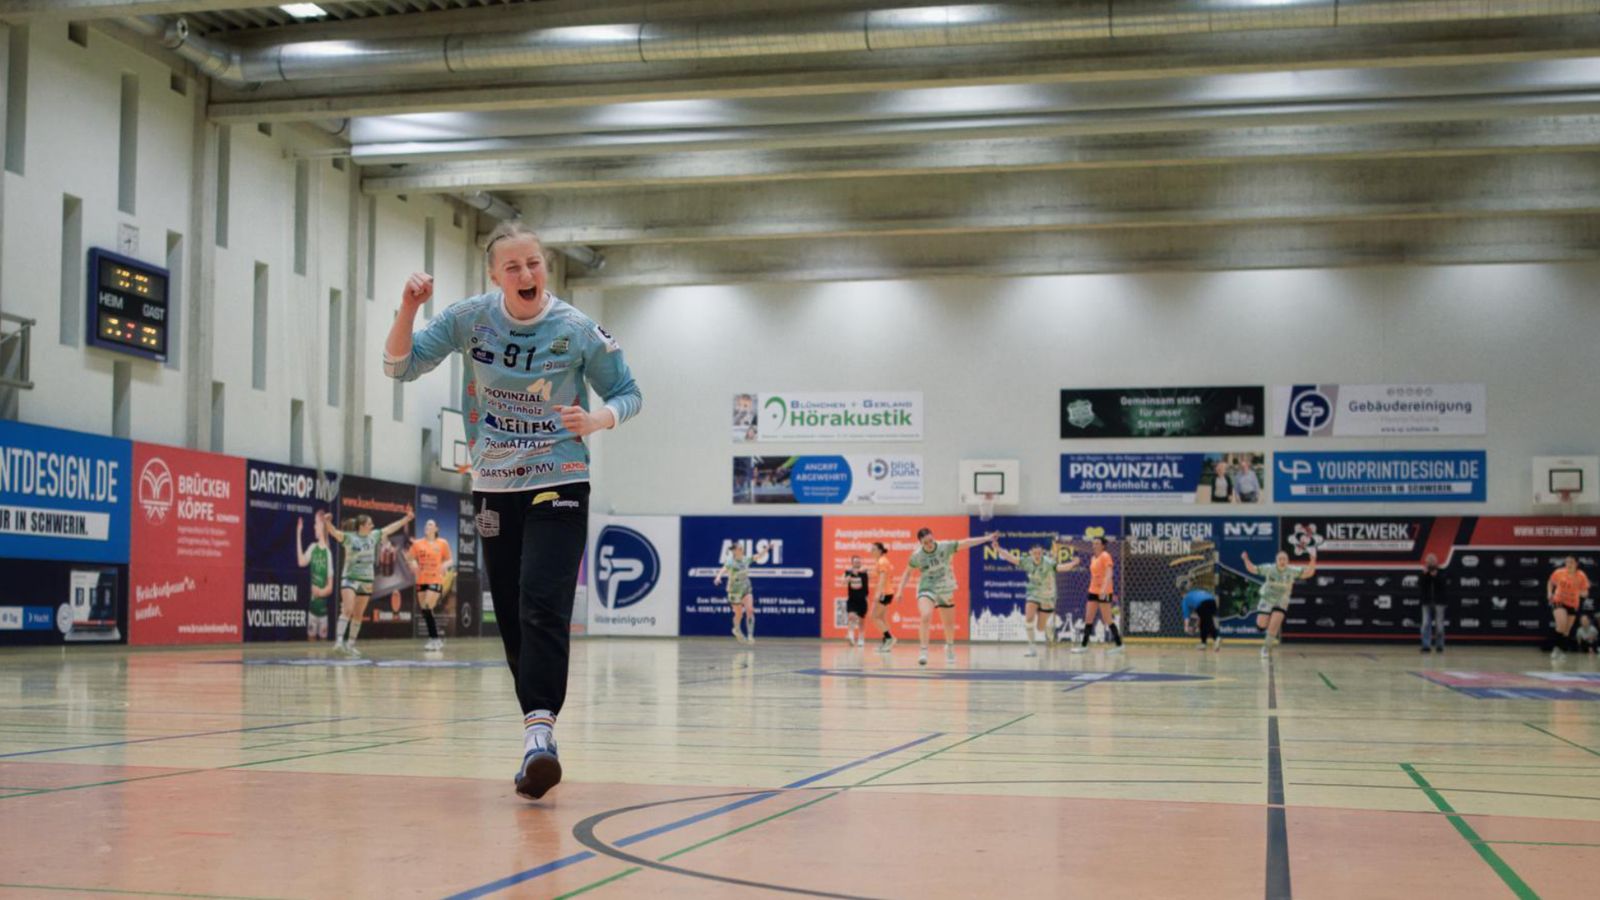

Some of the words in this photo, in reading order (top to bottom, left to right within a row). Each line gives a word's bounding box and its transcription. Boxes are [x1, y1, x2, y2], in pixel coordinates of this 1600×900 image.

[99, 291, 124, 310] HEIM
[142, 303, 165, 321] GAST
[503, 343, 537, 371] 91
[1120, 396, 1175, 405] Gemeinsam
[1176, 396, 1202, 405] stark
[1348, 400, 1473, 414] Gebäudereinigung
[790, 409, 912, 427] Hörakustik
[1139, 408, 1154, 417] für
[1155, 409, 1183, 417] unser
[1137, 419, 1185, 429] Schwerin!
[480, 467, 533, 478] DARTSHOP
[535, 462, 555, 474] MV
[1069, 462, 1184, 479] PROVINZIAL
[1316, 460, 1479, 480] YOURPRINTDESIGN.DE
[178, 472, 230, 499] BRÜCKEN
[249, 468, 314, 499] DARTSHOP
[1080, 479, 1103, 491] Jörg
[1104, 479, 1149, 490] Reinholz
[1163, 480, 1174, 490] K.
[177, 496, 214, 521] KÖPFE
[552, 500, 580, 508] Kempa
[15, 510, 27, 531] IN
[30, 511, 89, 536] SCHWERIN.
[1129, 522, 1153, 537] WIR
[1156, 522, 1212, 538] BEWEGEN
[1223, 521, 1273, 536] NVS
[1325, 523, 1410, 539] NETZWERK
[1129, 540, 1192, 555] SCHWERIN
[247, 583, 281, 602] IMMER
[282, 584, 298, 602] EIN
[246, 609, 307, 628] VOLLTREFFER
